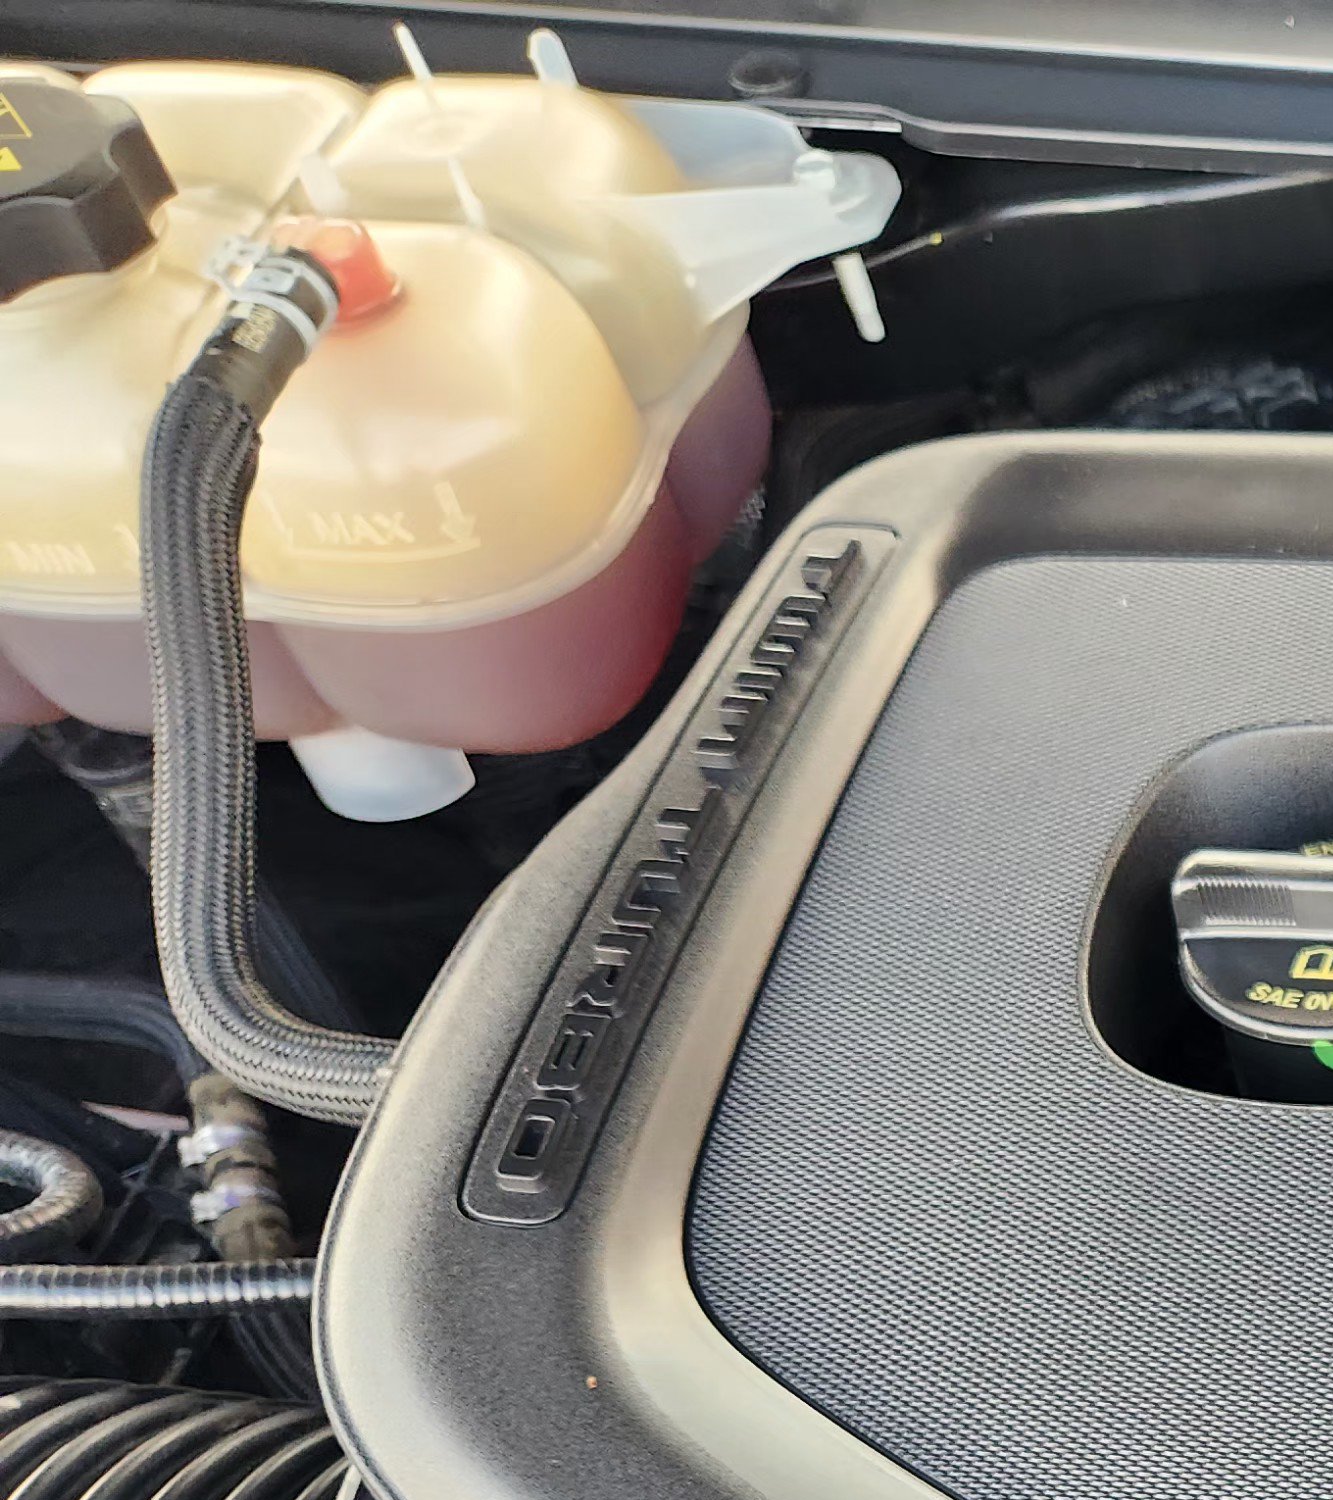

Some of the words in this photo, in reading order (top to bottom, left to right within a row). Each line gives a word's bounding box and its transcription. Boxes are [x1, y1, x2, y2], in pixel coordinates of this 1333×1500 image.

[306, 511, 417, 546] MAX
[692, 540, 863, 780] TWIN
[495, 784, 724, 1192] TURBO
[1246, 981, 1304, 1009] SAE
